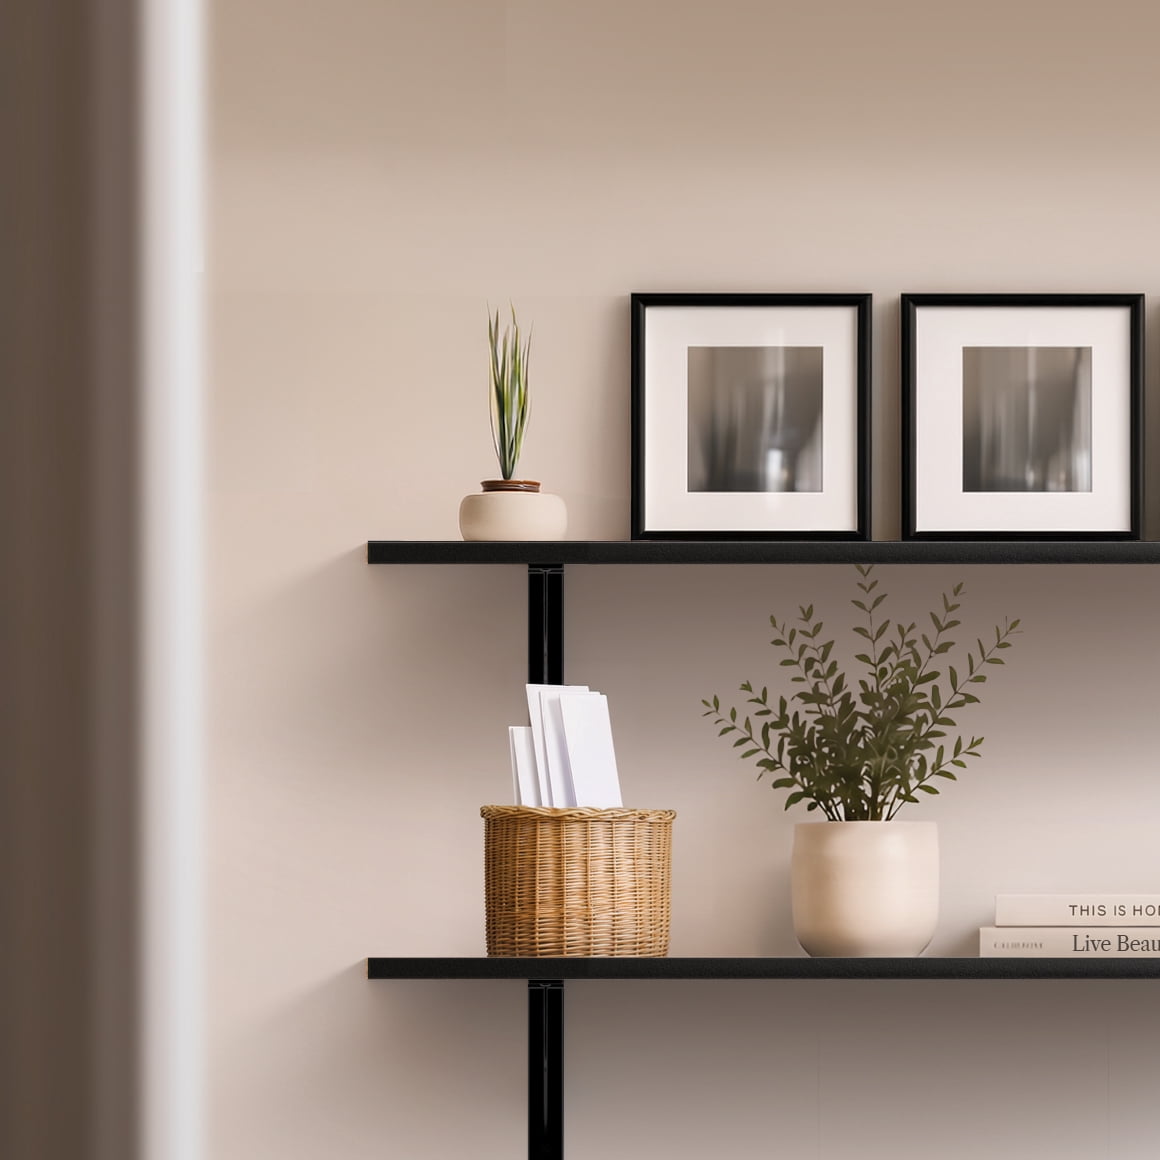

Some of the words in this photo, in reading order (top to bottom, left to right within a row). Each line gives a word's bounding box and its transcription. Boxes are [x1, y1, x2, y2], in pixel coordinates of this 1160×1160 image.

[1069, 904, 1107, 917] THIS
[1113, 904, 1127, 917] IS
[1072, 934, 1111, 952] Live
